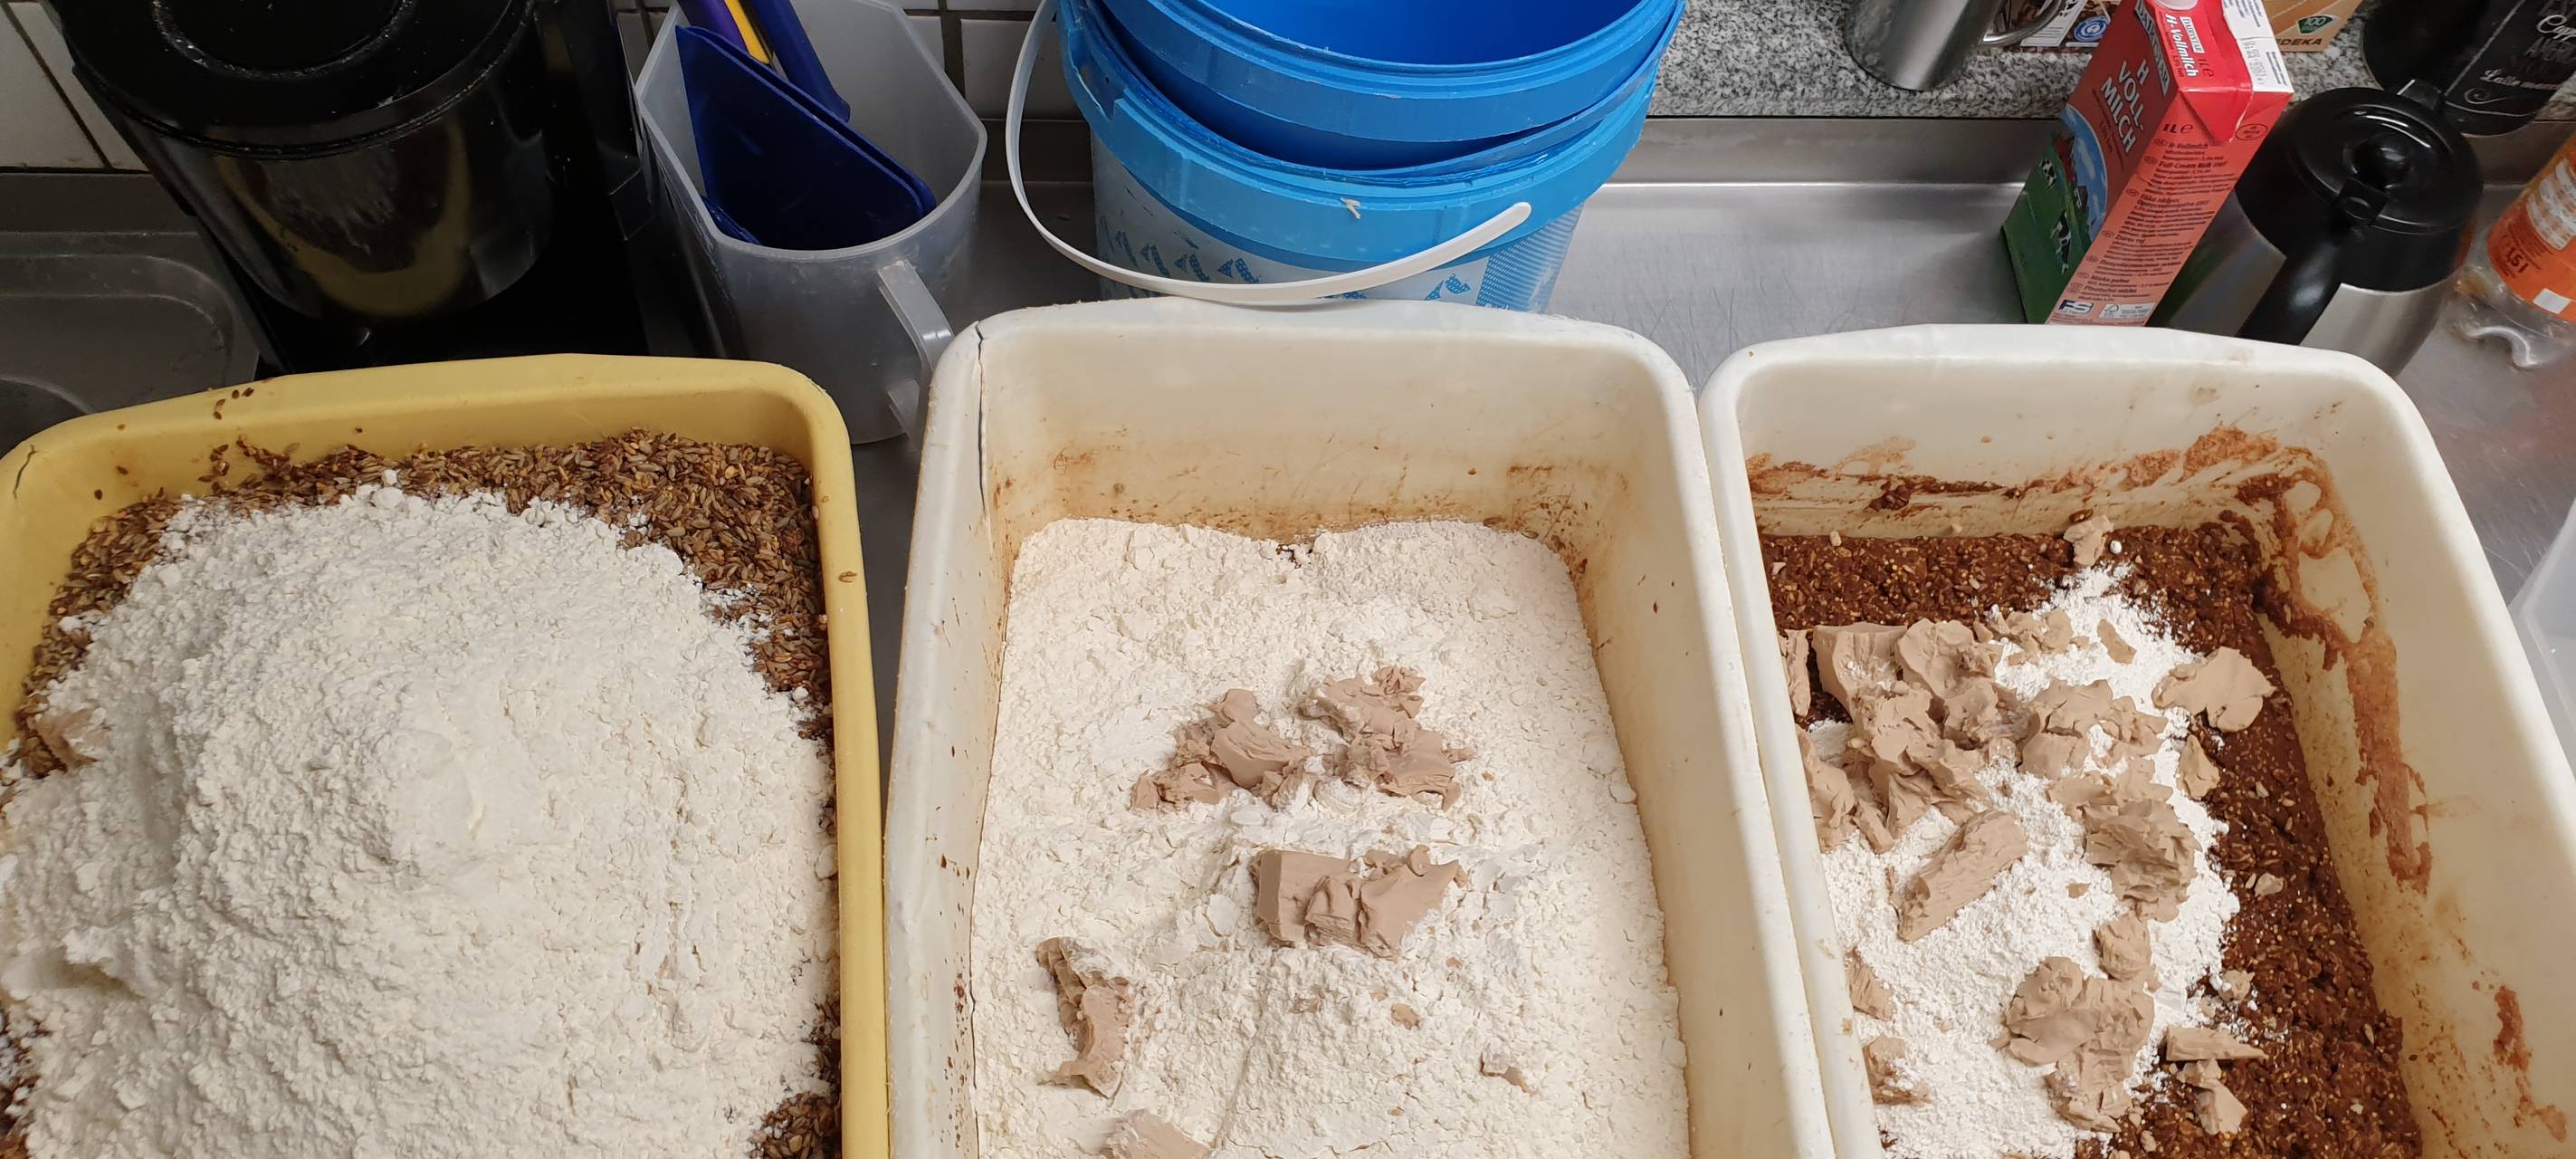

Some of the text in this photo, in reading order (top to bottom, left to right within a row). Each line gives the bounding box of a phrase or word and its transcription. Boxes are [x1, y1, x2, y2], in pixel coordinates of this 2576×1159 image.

[2136, 58, 2150, 87] H
[2164, 14, 2199, 77] H-Vollmilch
[2100, 76, 2137, 154] MILCH
[2118, 59, 2144, 131] VOLL-
